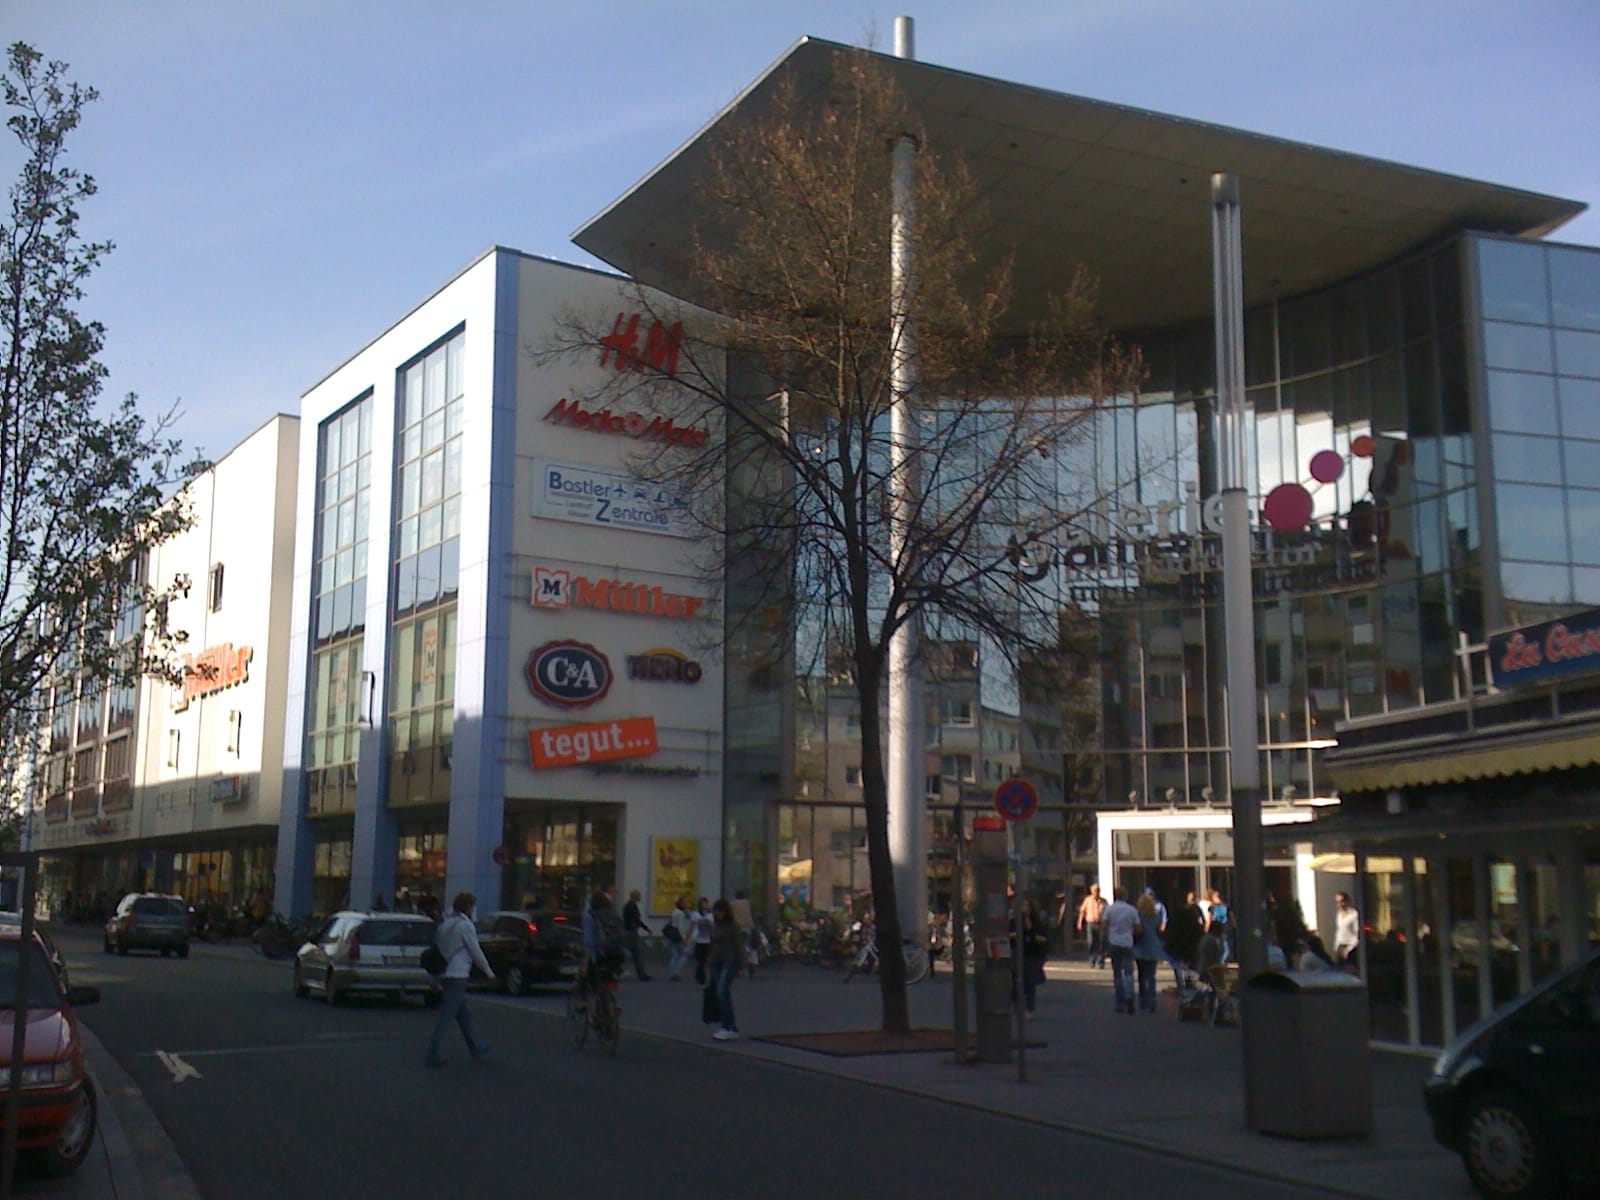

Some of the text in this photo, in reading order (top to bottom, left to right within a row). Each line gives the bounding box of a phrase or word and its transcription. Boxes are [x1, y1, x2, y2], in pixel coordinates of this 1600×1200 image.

[549, 472, 610, 498] Bastler
[595, 500, 669, 524] Zentrale
[543, 576, 704, 617] M Müller
[546, 657, 598, 689] C&A
[540, 723, 650, 761] tegut...
